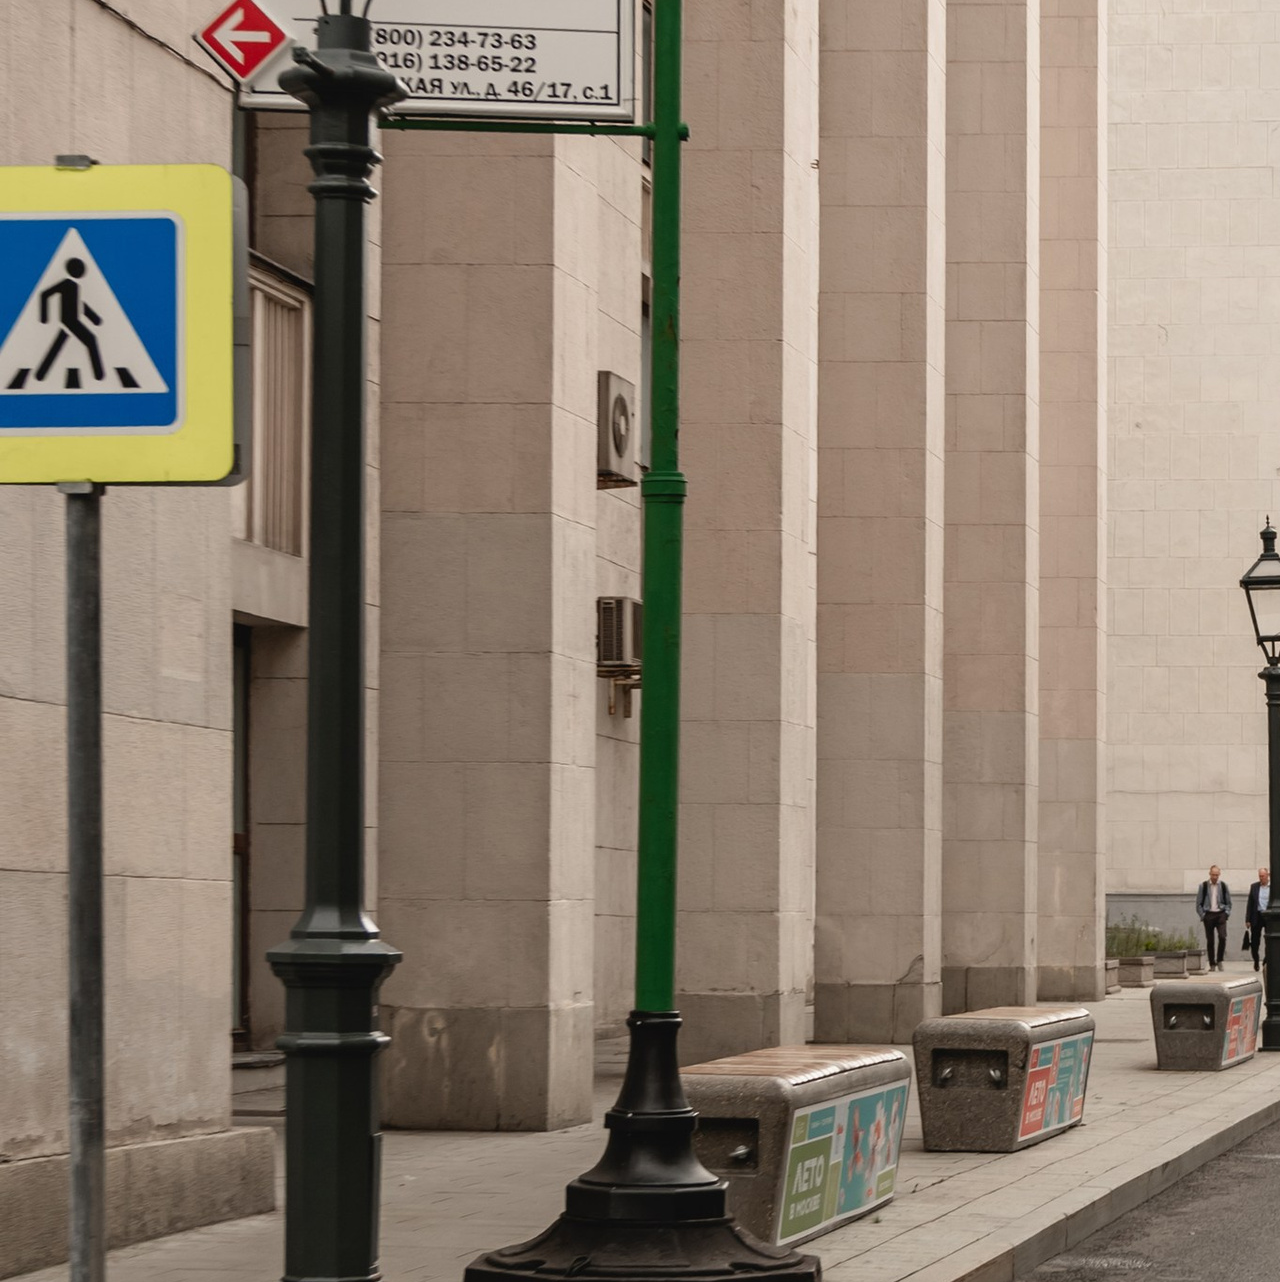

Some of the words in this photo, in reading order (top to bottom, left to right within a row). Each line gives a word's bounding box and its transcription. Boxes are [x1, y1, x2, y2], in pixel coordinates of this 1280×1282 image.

[429, 30, 537, 51] 234-73-63
[429, 53, 537, 74] 138-65-22
[791, 1154, 825, 1196] ЛЕТО
